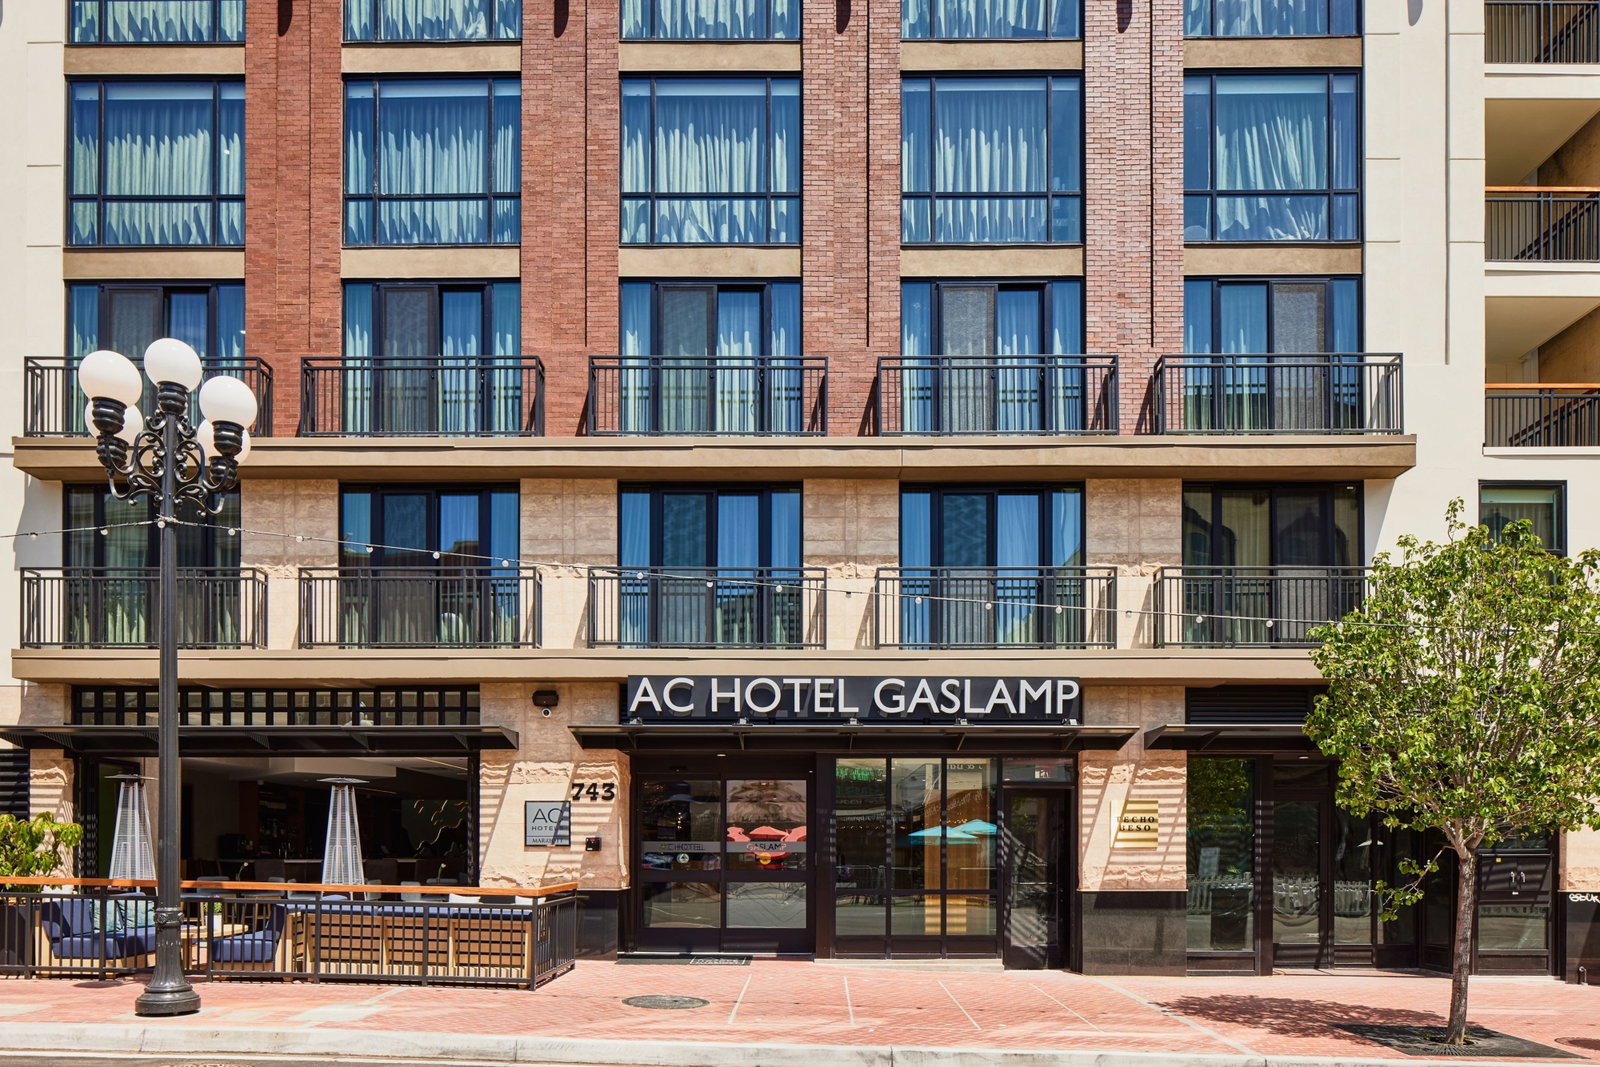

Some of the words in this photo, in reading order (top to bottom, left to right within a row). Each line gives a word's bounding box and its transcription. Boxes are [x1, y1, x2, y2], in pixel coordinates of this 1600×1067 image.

[629, 677, 695, 713] AC
[711, 677, 859, 714] HOTEL
[873, 678, 1080, 715] GASLAMP
[571, 783, 615, 801] 743
[532, 808, 562, 823] AC
